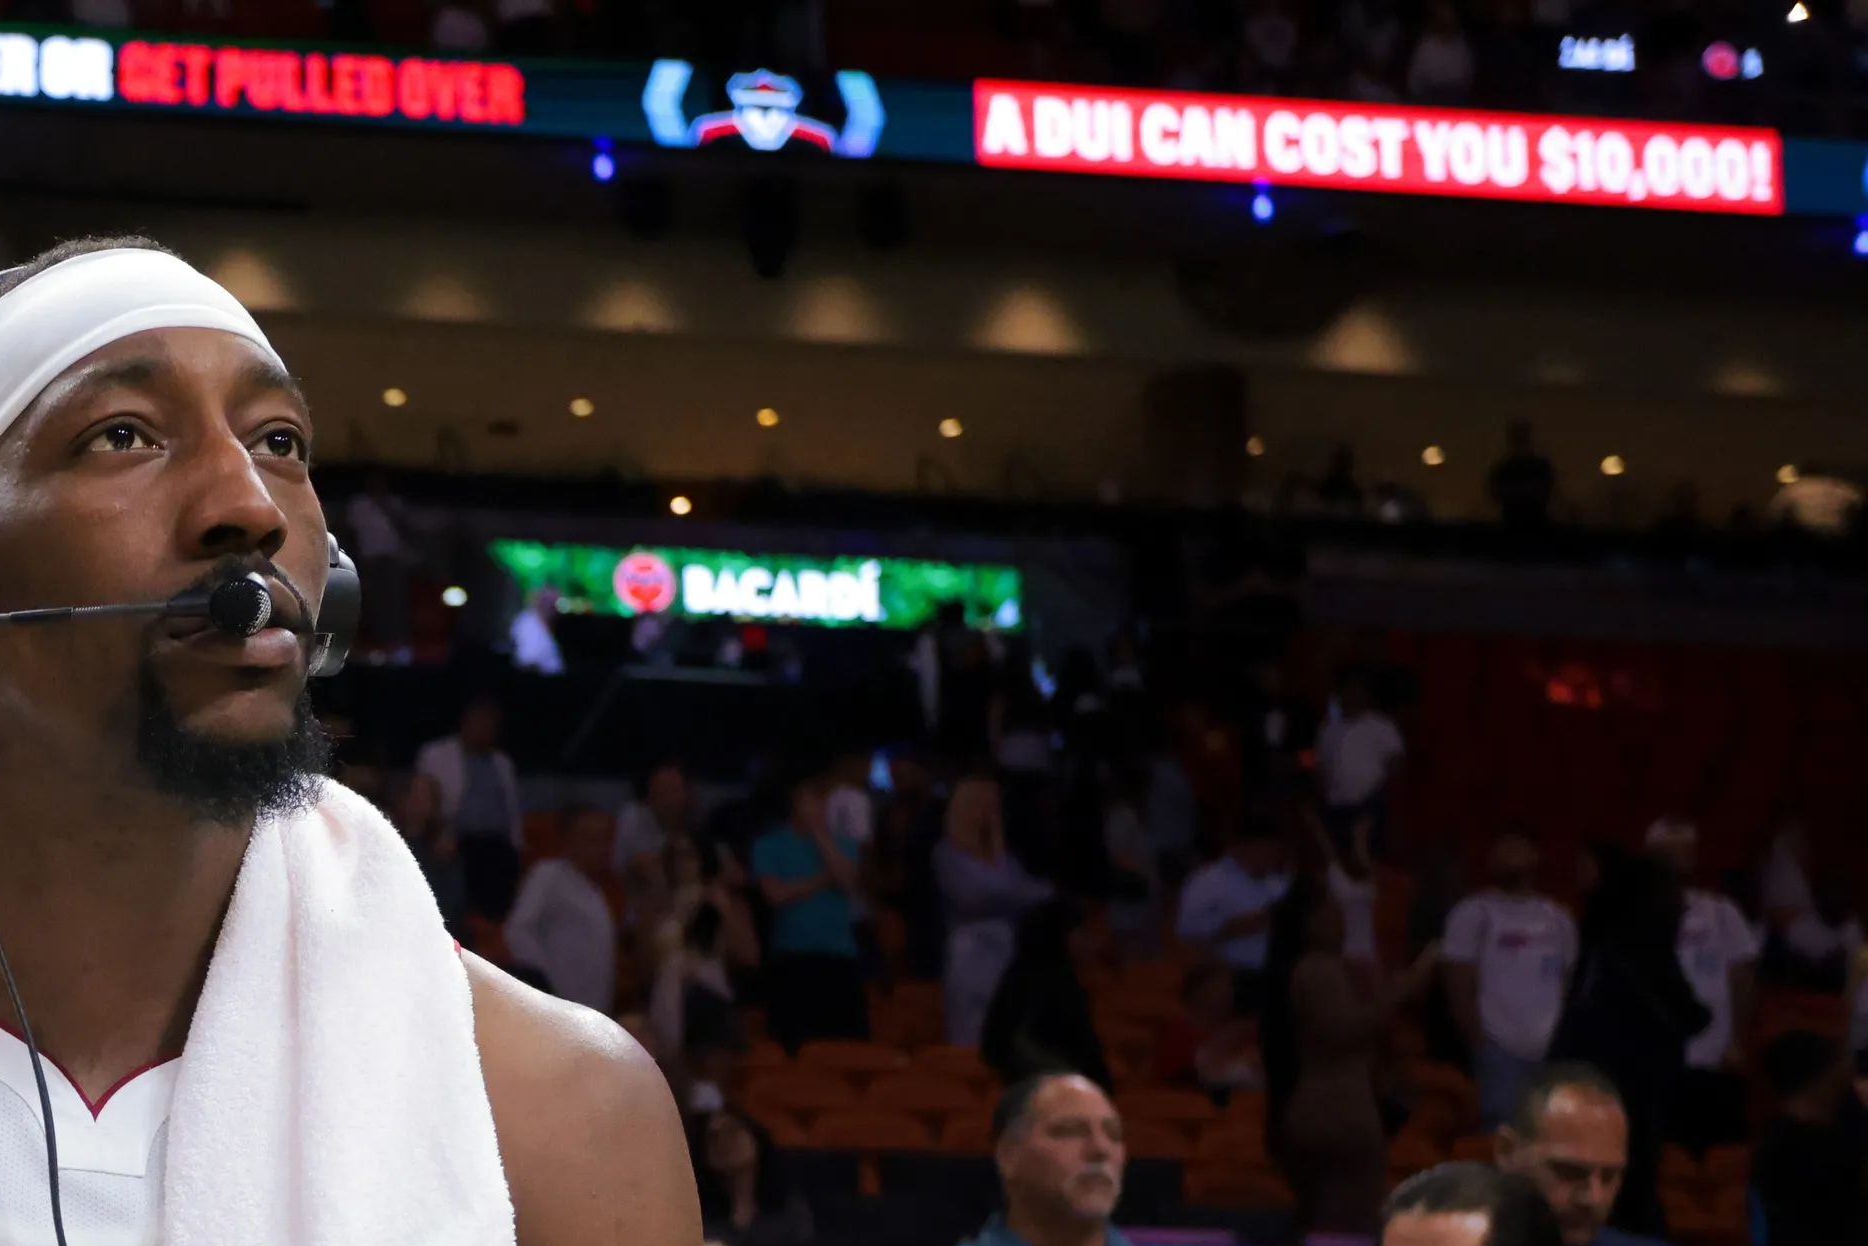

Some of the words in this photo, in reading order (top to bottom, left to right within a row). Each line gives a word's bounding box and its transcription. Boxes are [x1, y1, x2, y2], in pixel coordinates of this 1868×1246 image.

[38, 34, 115, 101] OR
[117, 40, 212, 106] GET
[213, 46, 396, 117] PULLED
[395, 57, 526, 126] OVER
[982, 93, 1028, 156] A
[1031, 95, 1133, 163] DUI
[1138, 102, 1259, 171] CAN
[1262, 109, 1409, 180] COST
[1414, 119, 1529, 188] YOU
[1536, 124, 1775, 202] $10,000!
